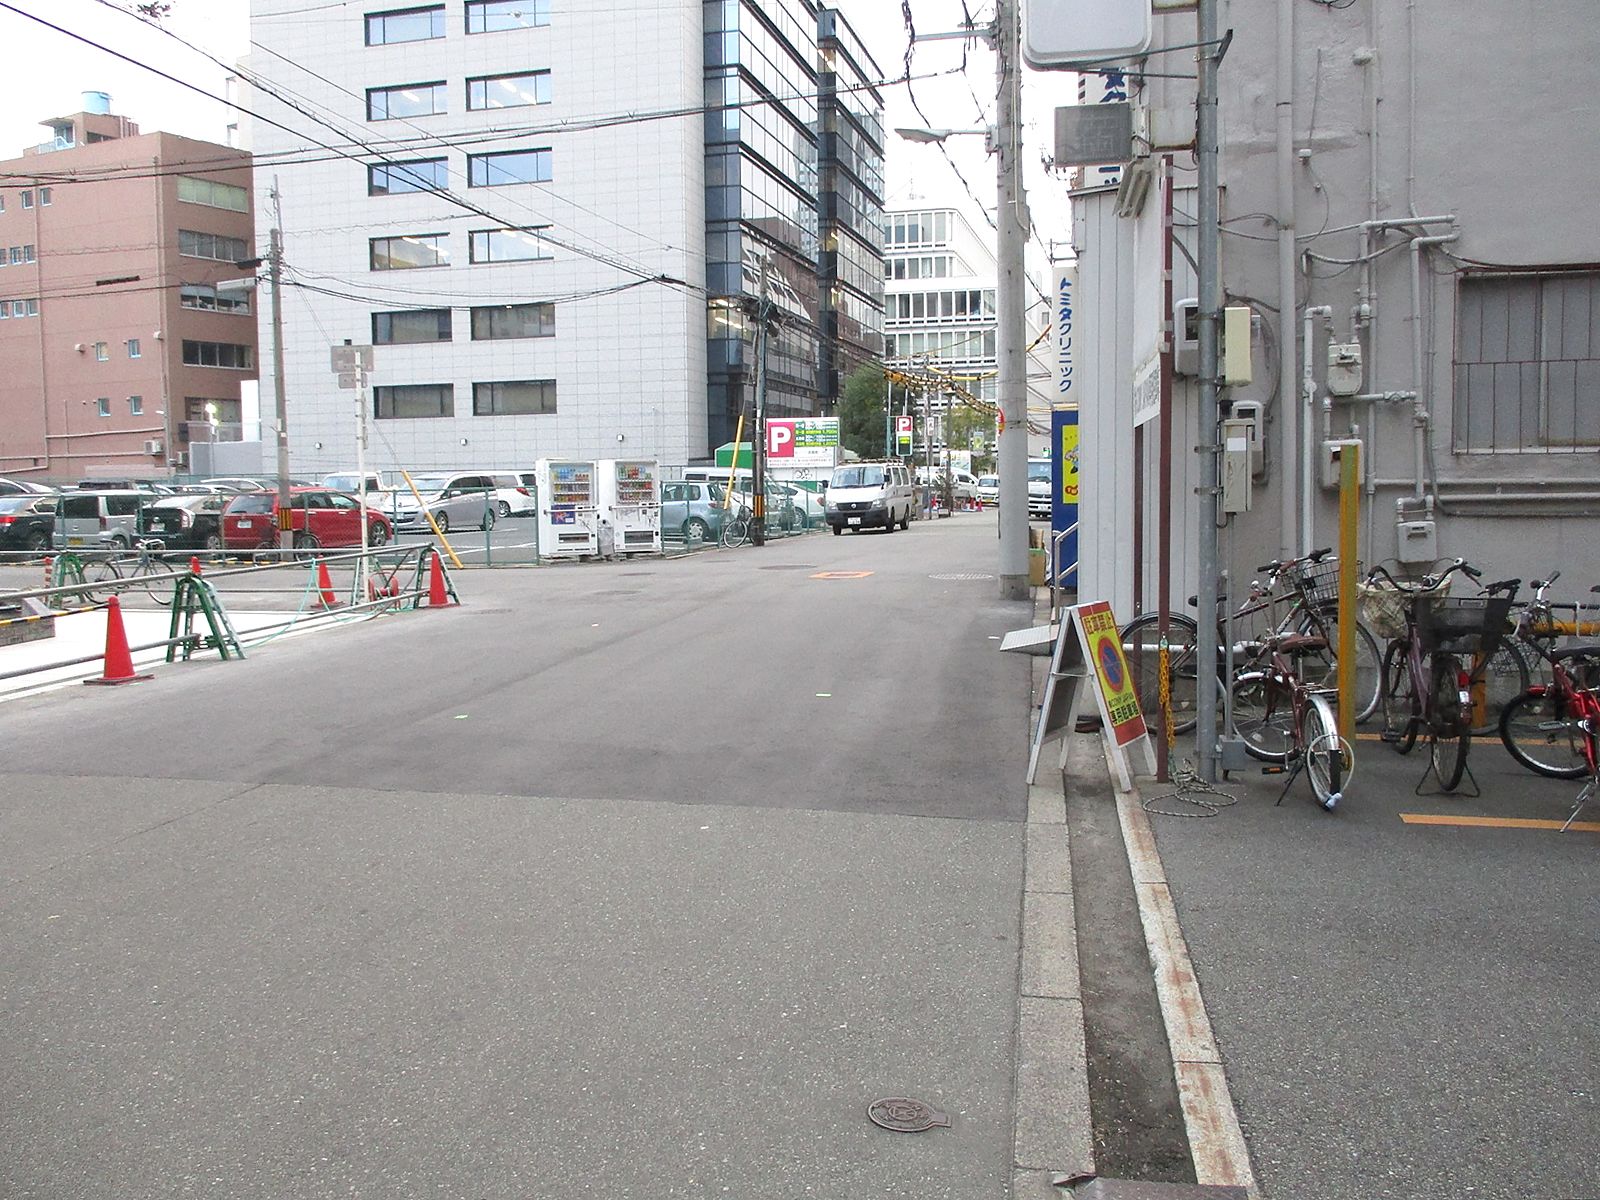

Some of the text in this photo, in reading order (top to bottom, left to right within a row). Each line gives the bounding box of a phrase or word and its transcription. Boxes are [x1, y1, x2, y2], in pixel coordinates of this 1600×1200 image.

[1058, 277, 1073, 393] トミタクリニック
[898, 417, 911, 432] P
[770, 426, 792, 453] P
[1083, 612, 1114, 635] 駐車禁止
